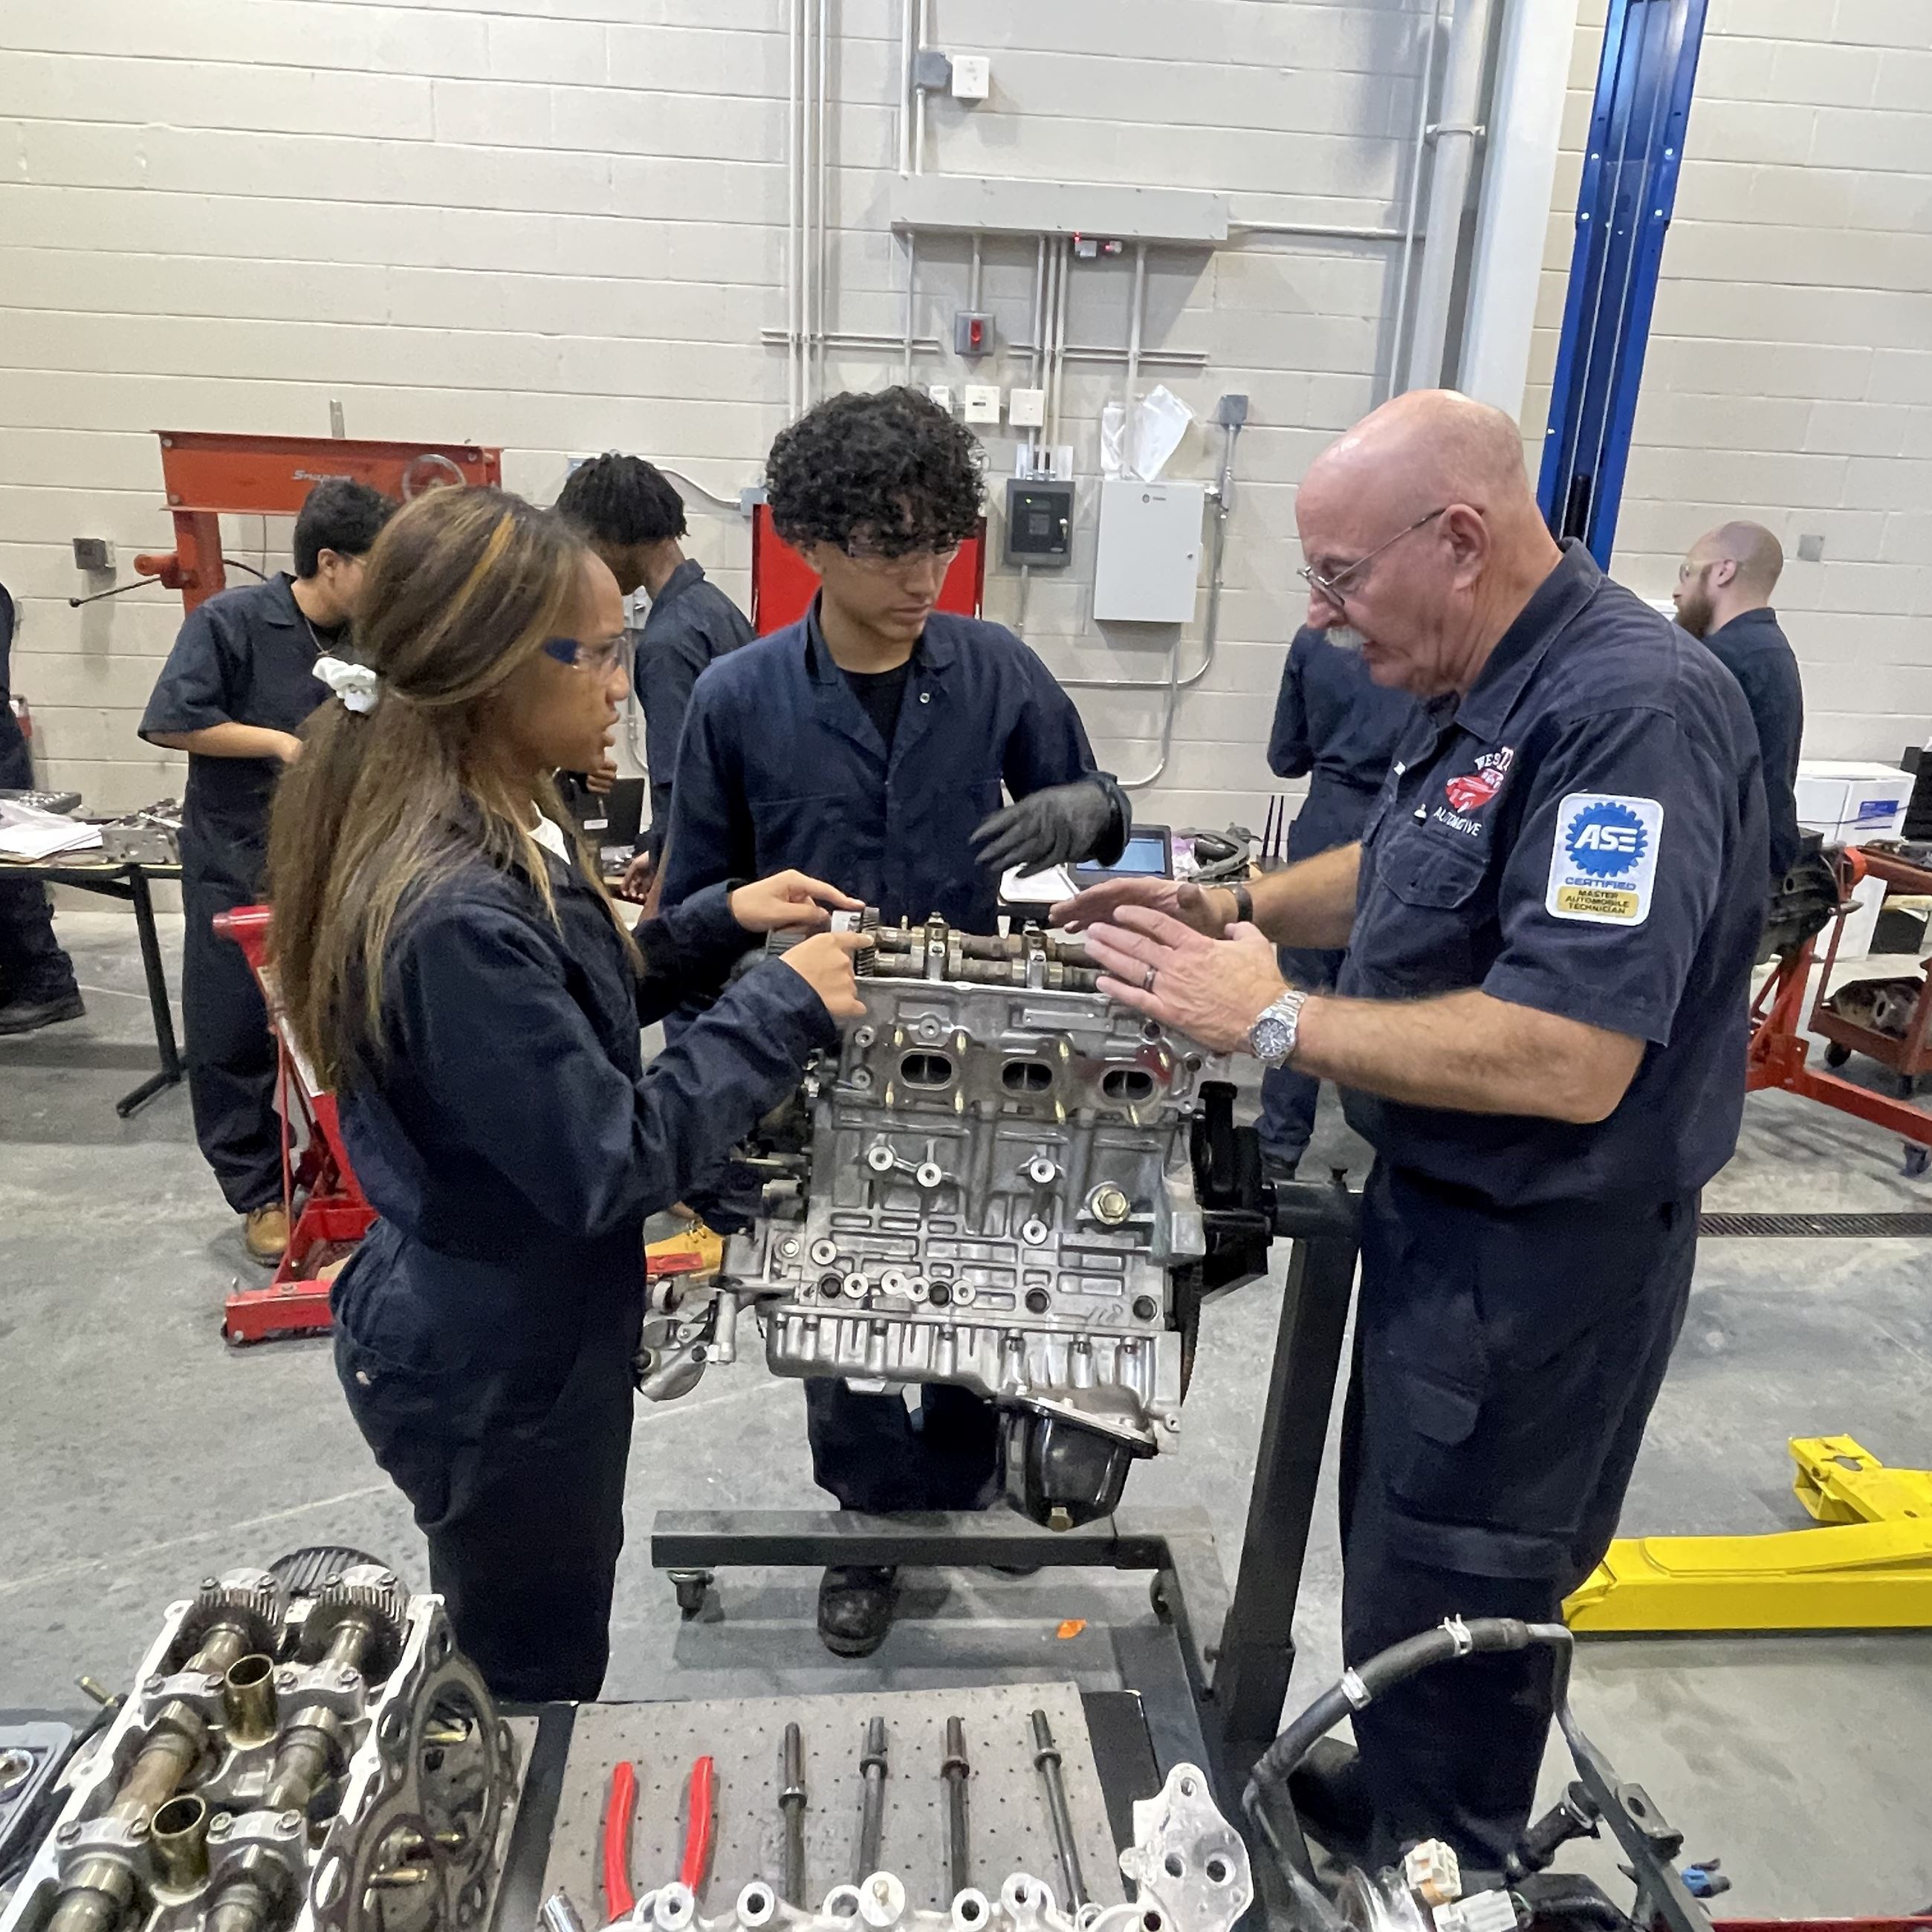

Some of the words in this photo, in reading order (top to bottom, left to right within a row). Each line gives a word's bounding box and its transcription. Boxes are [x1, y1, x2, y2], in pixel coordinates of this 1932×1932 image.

[1574, 824, 1638, 853] ASE
[1565, 876, 1636, 891] CERTIFIED
[1578, 889, 1619, 899] MASTER
[1565, 895, 1630, 909] AUTOMOBILE
[1568, 902, 1626, 915] TECHNICIAN
